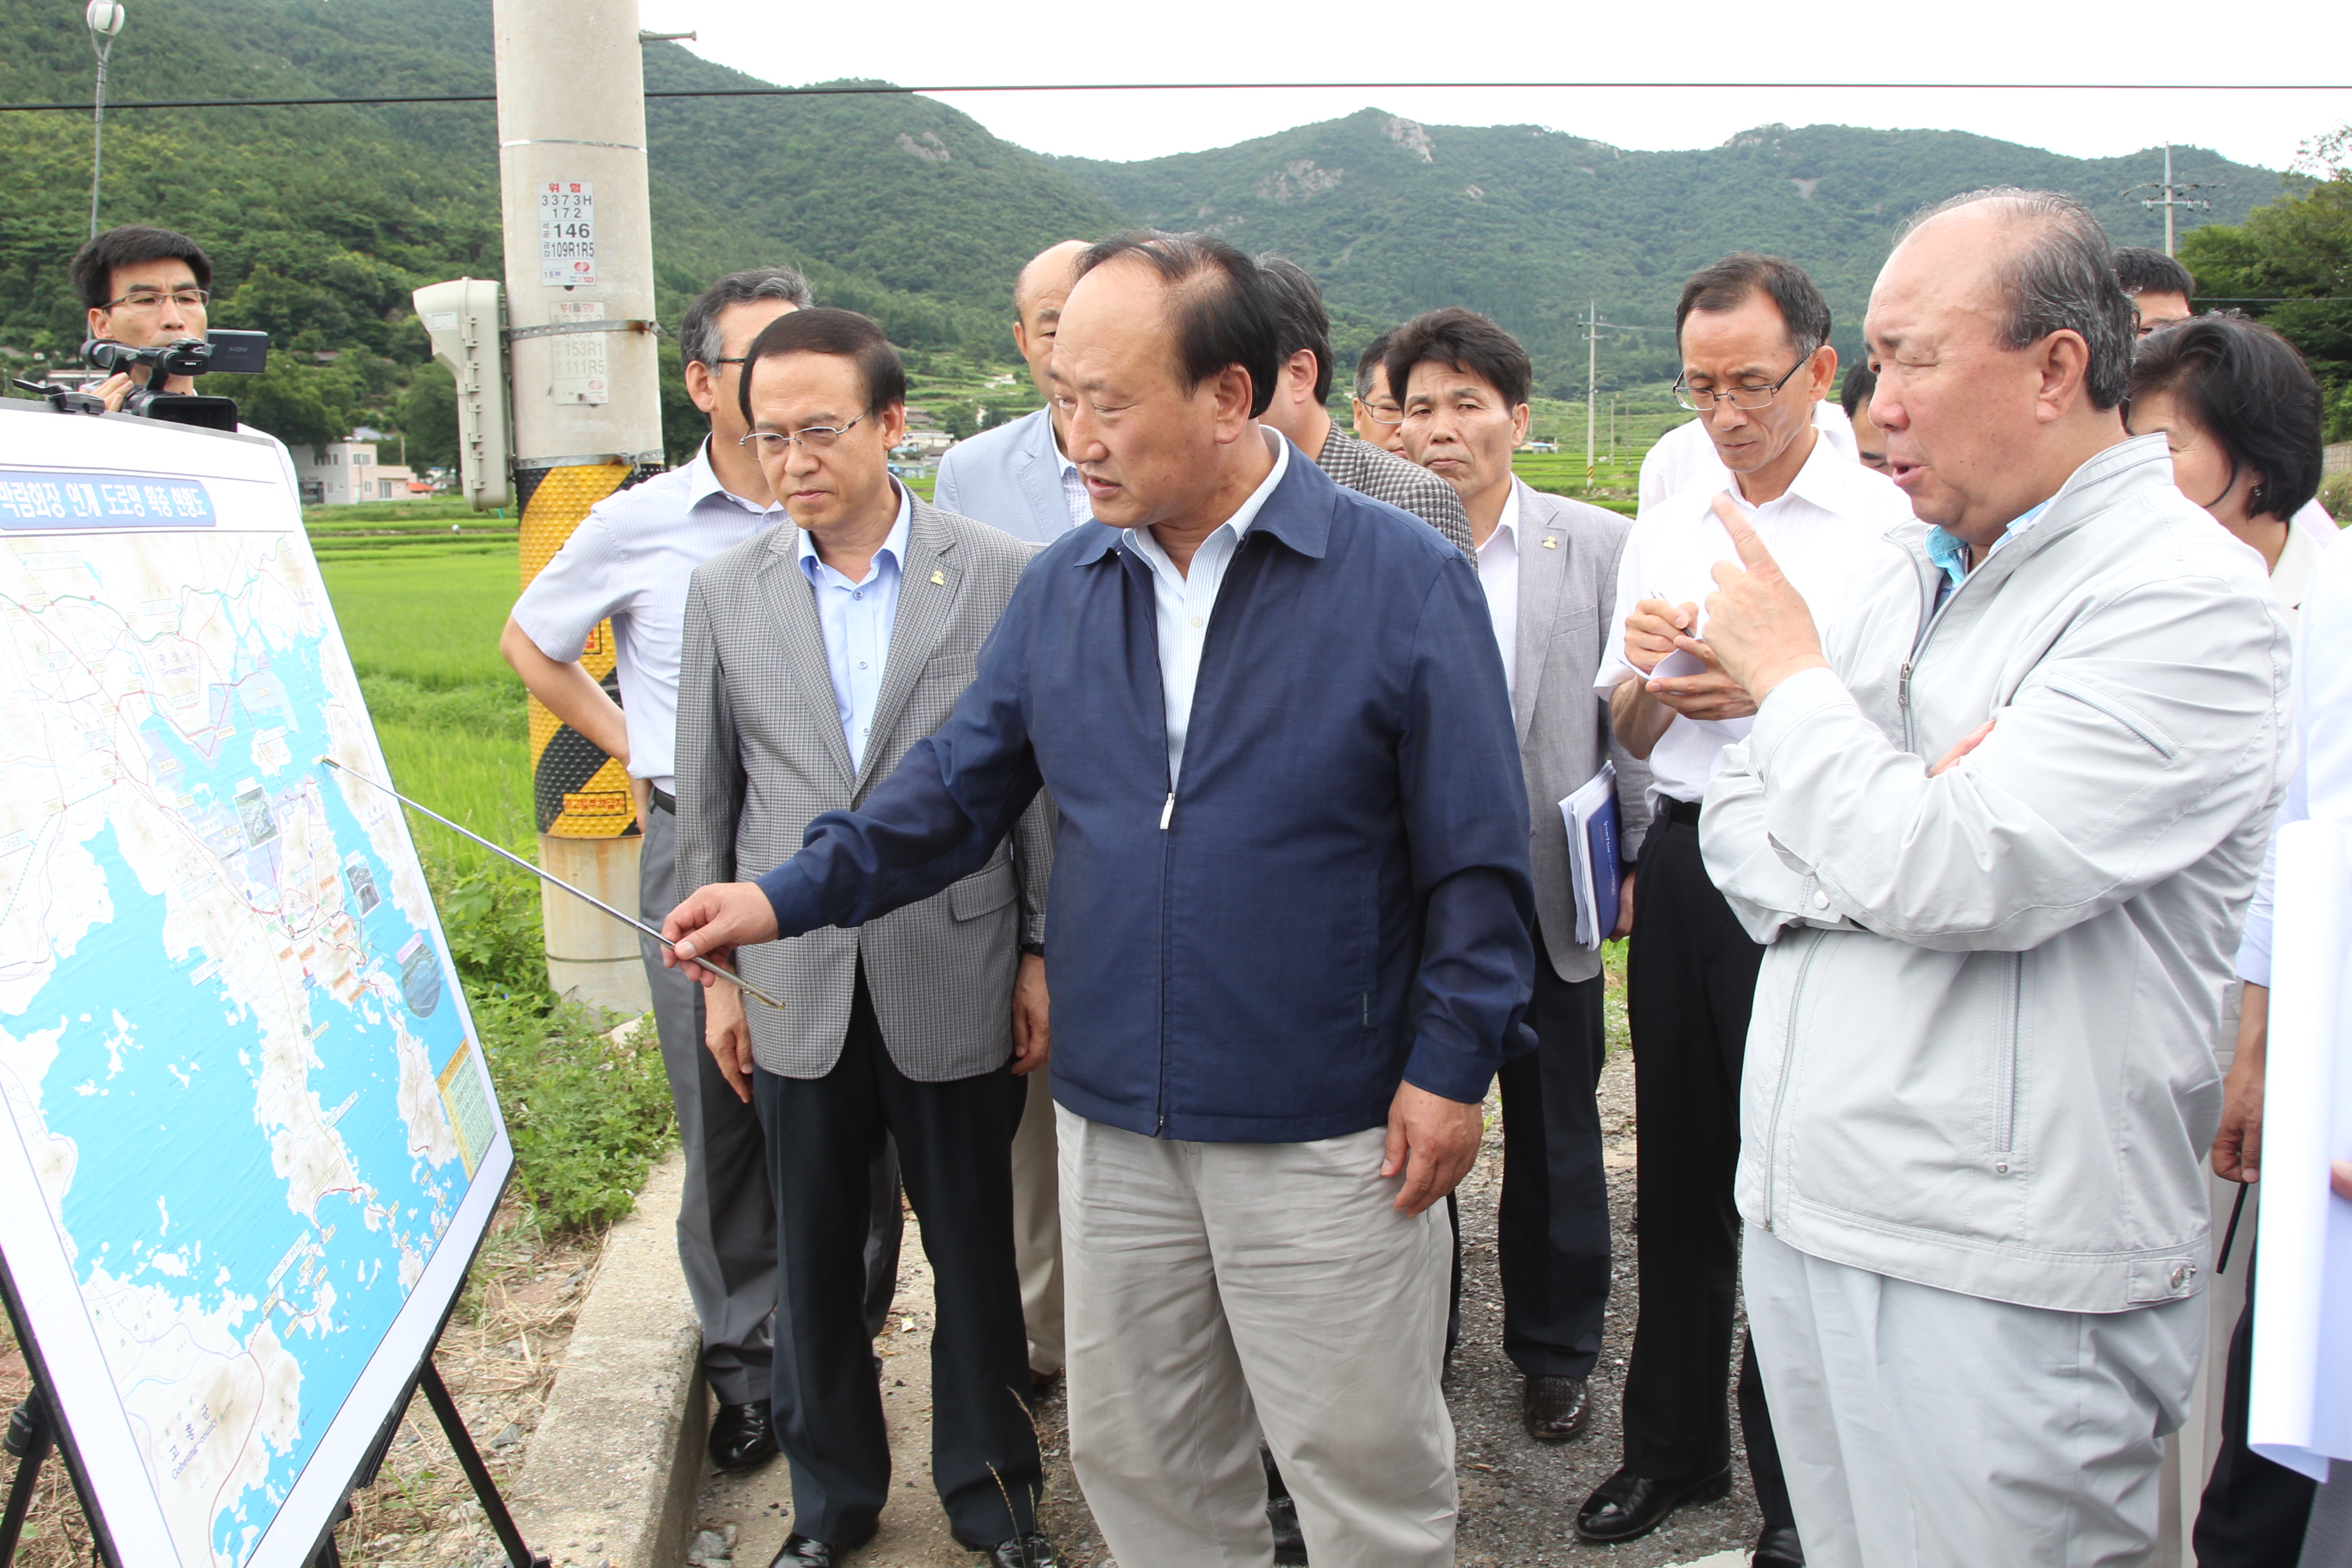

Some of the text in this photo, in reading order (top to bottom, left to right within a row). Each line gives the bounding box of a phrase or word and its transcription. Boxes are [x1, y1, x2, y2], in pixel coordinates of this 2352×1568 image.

[552, 208, 581, 218] 172
[554, 223, 590, 238] 146
[552, 242, 594, 258] 109R1R5
[565, 342, 603, 356] 153R1
[567, 360, 605, 375] 111R5
[0, 481, 207, 518] 박람회장 연계 도로망 확충 현황도
